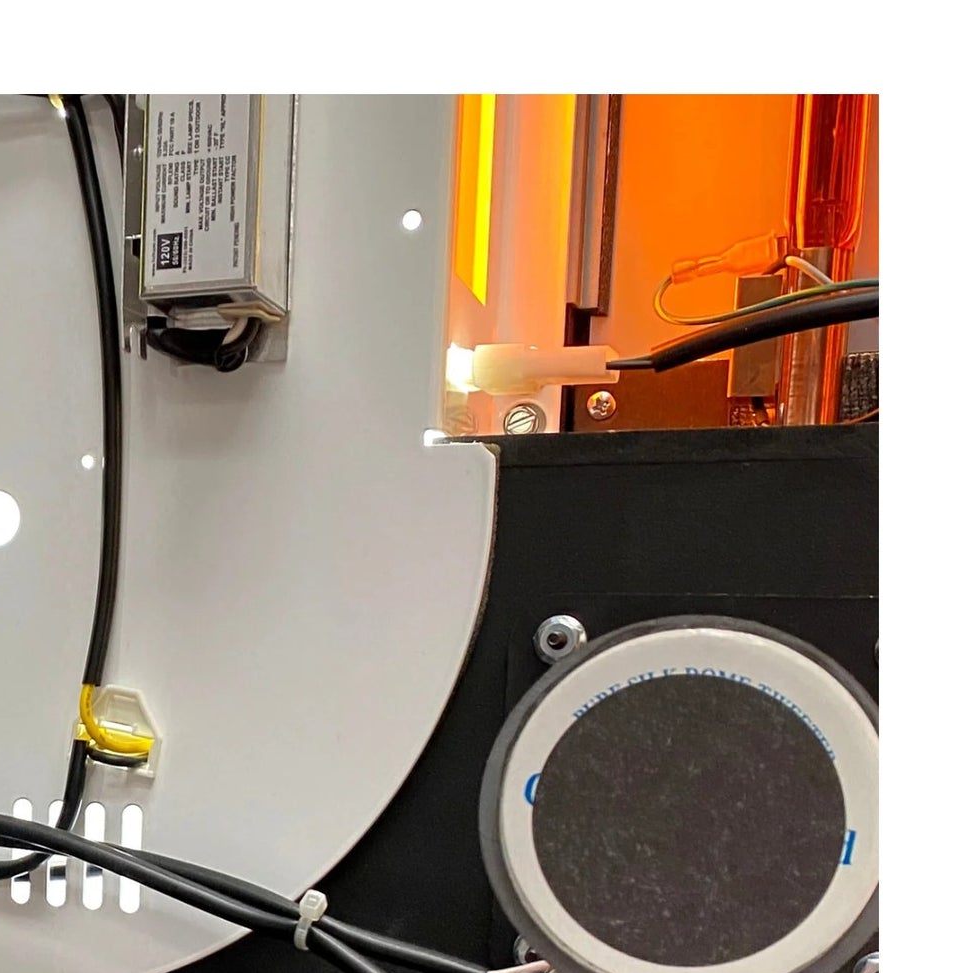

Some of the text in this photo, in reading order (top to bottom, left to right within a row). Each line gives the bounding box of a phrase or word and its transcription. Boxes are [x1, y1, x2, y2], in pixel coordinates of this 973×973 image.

[195, 139, 199, 148] OR
[205, 186, 210, 194] TO
[205, 196, 210, 205] OR
[161, 239, 170, 265] 120V
